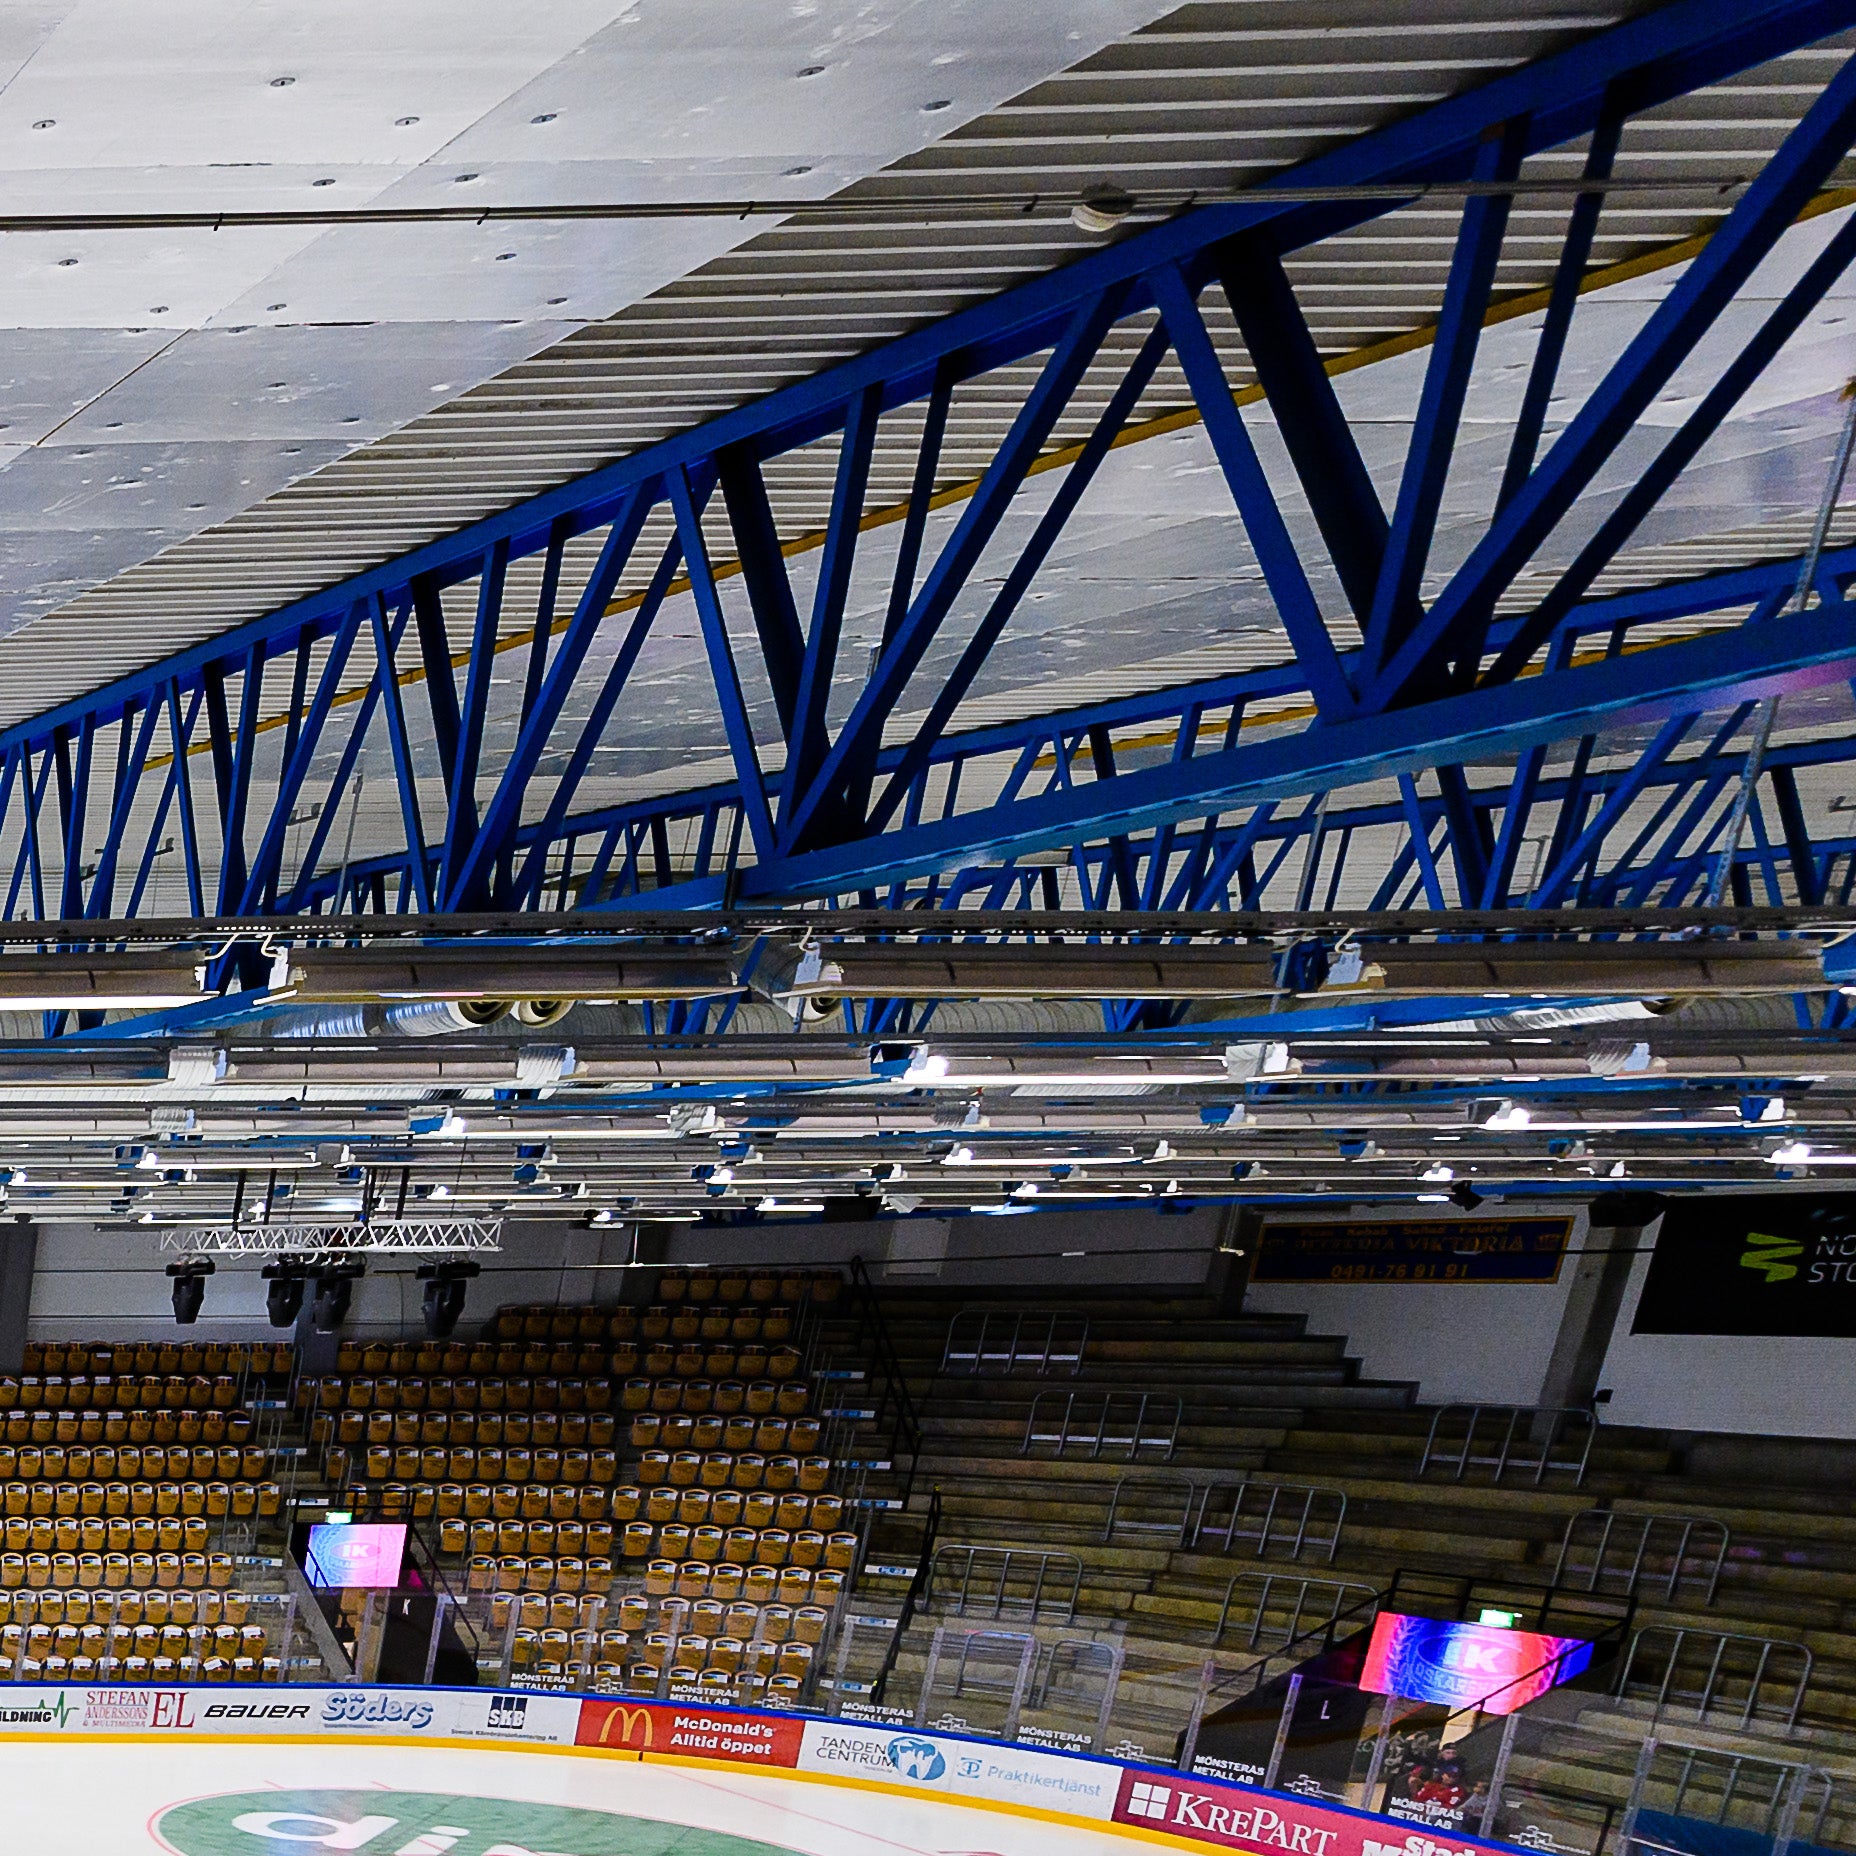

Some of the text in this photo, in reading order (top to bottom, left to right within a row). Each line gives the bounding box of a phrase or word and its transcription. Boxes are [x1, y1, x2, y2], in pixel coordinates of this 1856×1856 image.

[86, 1691, 195, 1728] STEFAN EL
[321, 1692, 434, 1730] Söders
[714, 1697, 730, 1706] AB
[84, 1706, 148, 1719] ANDERSSONS
[840, 1710, 904, 1726] METALL AB
[674, 1716, 774, 1738] McDonald's
[670, 1733, 772, 1756] Alltid öppet
[1017, 1735, 1082, 1752] METALL AB
[816, 1747, 896, 1767] CENTRUM
[987, 1765, 1102, 1797] Praktikertjänst
[1193, 1765, 1236, 1781] METALL
